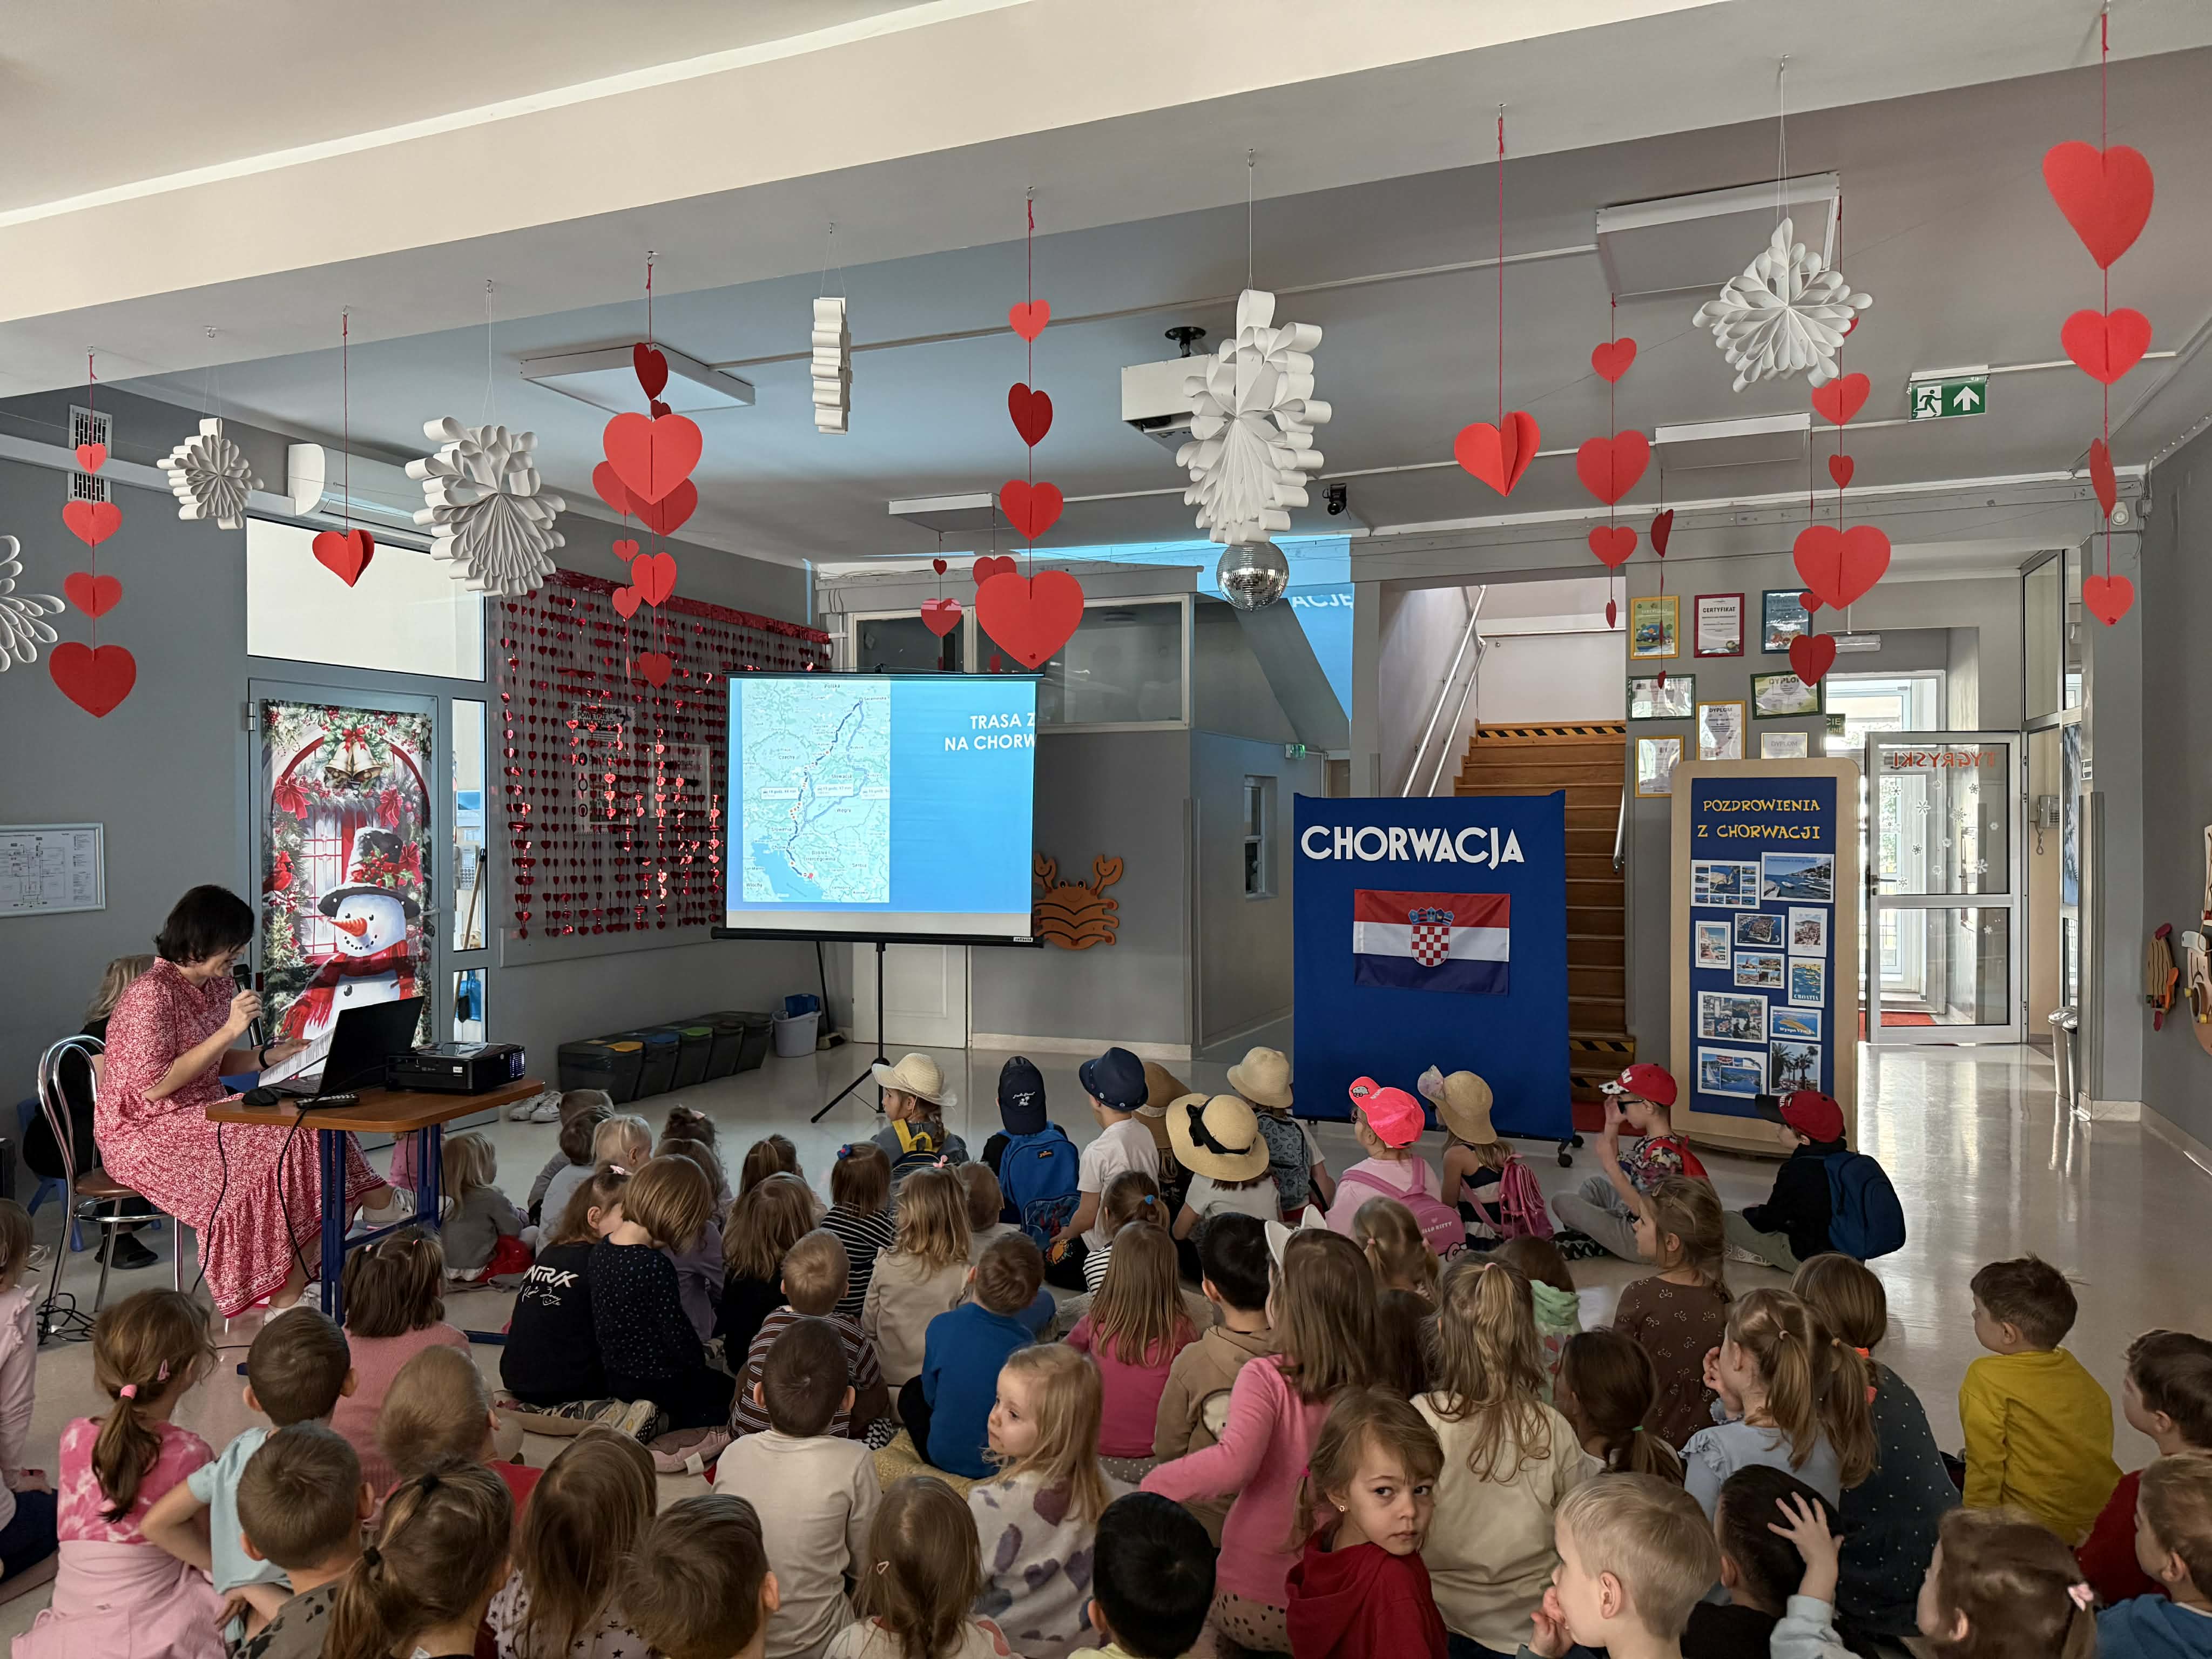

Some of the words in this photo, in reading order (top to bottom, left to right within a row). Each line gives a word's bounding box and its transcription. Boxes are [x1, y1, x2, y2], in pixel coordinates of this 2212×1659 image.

[970, 713, 1022, 729] TRASA
[1027, 712, 1035, 726] Z
[945, 737, 969, 751] NA
[974, 733, 1035, 750] CHORW
[1703, 799, 1820, 812] POZDROWIENIA
[1697, 825, 1708, 837] Z
[1716, 824, 1820, 839] CHORWACJI
[1301, 825, 1525, 870] CHORWACJA
[1435, 1221, 1452, 1230] KITTY
